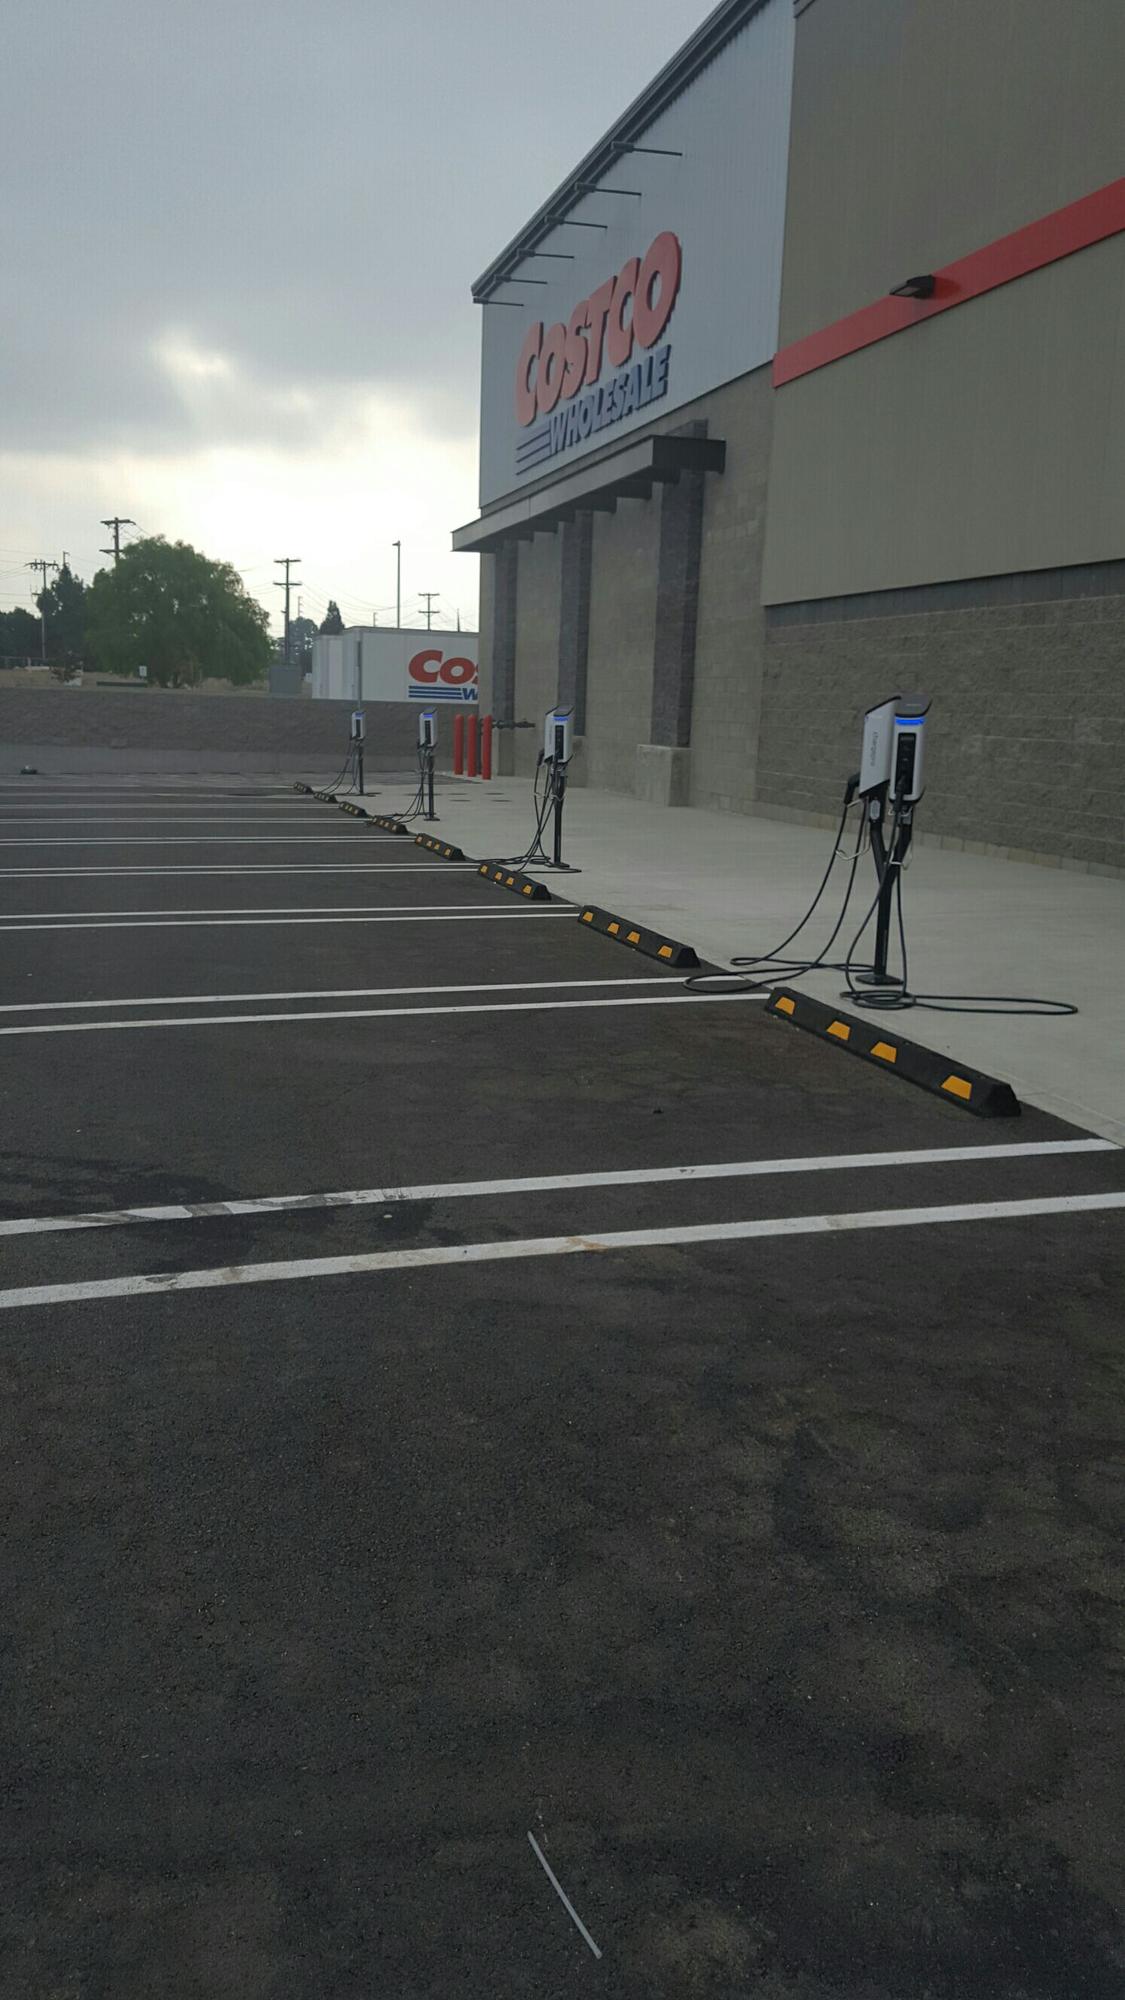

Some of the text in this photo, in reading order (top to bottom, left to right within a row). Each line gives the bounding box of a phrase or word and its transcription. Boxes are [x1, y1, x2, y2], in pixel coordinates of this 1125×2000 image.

[516, 231, 682, 427] COSTCO
[549, 344, 672, 455] WHOLESALE
[409, 649, 478, 684] CO
